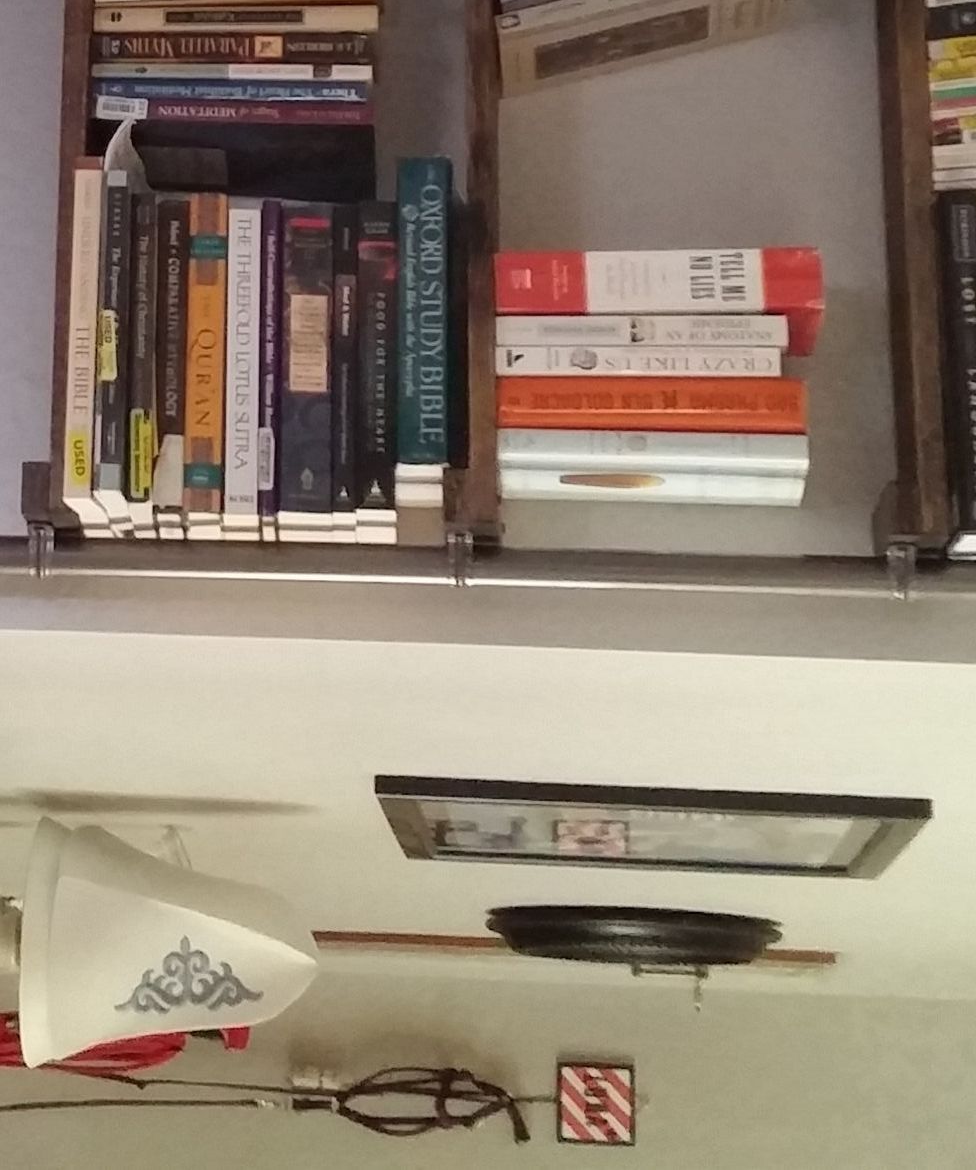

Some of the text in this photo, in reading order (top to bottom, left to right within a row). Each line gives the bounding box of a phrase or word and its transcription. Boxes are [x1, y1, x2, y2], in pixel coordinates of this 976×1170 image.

[158, 105, 237, 118] MEDITATION
[138, 235, 149, 252] The
[419, 184, 443, 274] OXFORD
[136, 255, 149, 289] History
[404, 257, 416, 288] English
[689, 255, 716, 300] NO LIES
[719, 252, 747, 302] TELL ME
[166, 257, 180, 340] COMPARATIVE
[406, 289, 417, 311] Bible
[104, 315, 113, 344] USED
[135, 304, 149, 359] Christianity
[406, 312, 416, 332] with
[419, 280, 444, 362] STUDY
[74, 326, 90, 359] THE
[233, 217, 252, 470] THE THREEFOLD LOTUS SUTRA
[375, 339, 386, 366] FOR
[406, 333, 416, 348] the
[604, 355, 773, 371] CRAZY LIKE US
[72, 366, 89, 415] BIBLE
[375, 374, 386, 400] THE
[419, 366, 445, 445] BIBLE
[73, 439, 86, 477] USED
